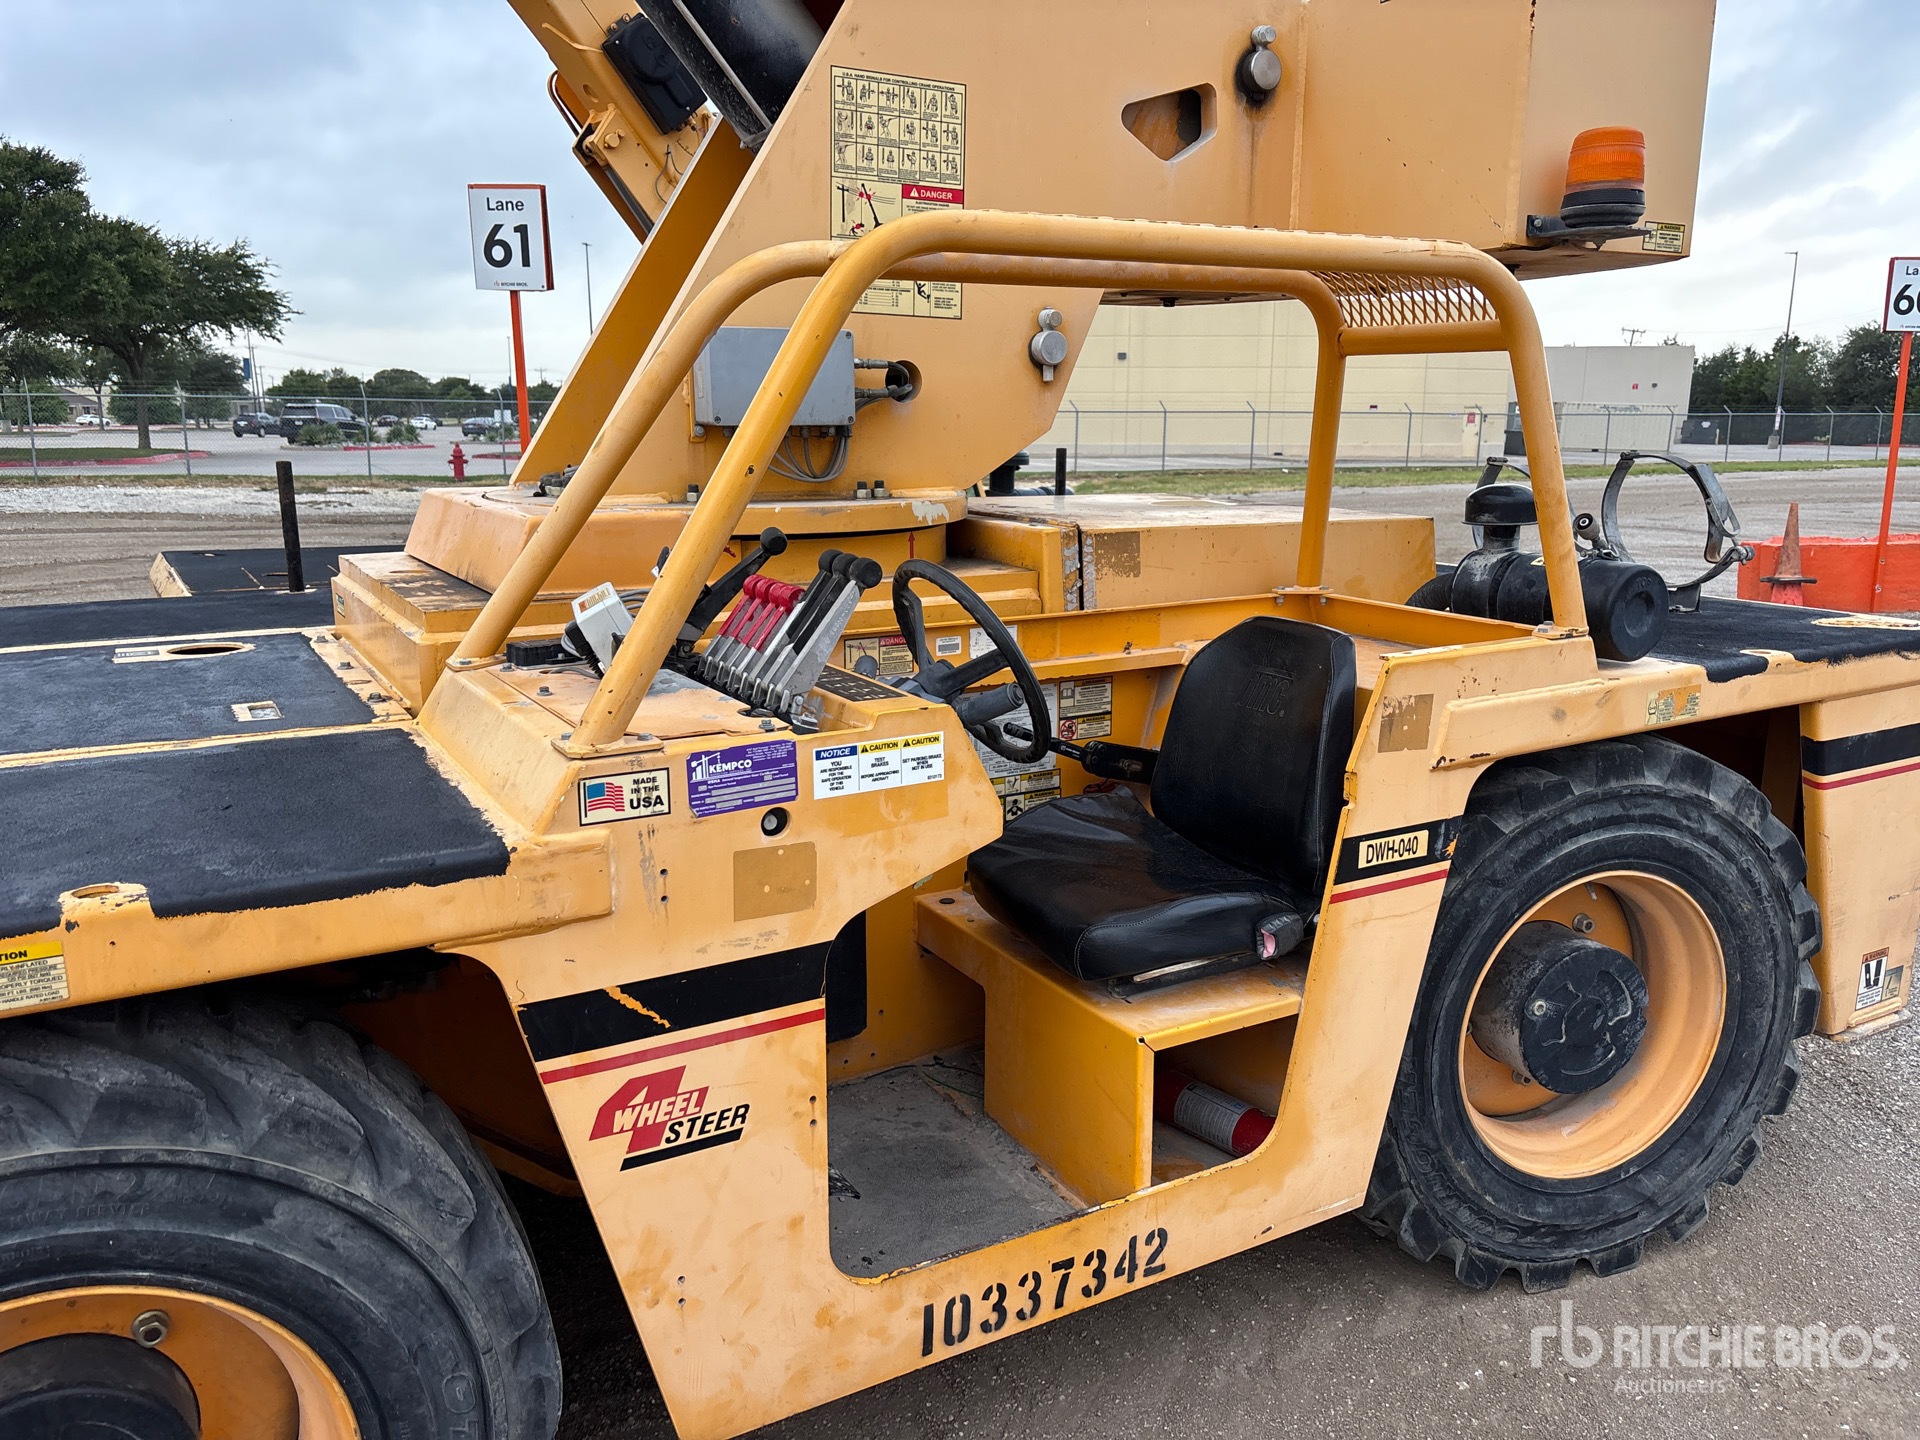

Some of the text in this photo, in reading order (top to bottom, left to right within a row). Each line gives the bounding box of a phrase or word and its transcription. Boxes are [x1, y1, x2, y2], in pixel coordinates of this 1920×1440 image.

[920, 190, 952, 200] DANGER
[486, 197, 524, 211] Lane
[484, 224, 530, 268] 61
[1905, 266, 1919, 276] La
[1893, 284, 1920, 316] 6
[911, 736, 940, 746] CAUTION
[869, 742, 899, 751] CAUTION
[821, 748, 851, 758] NOTICE
[708, 759, 752, 774] KEMPCO
[633, 776, 657, 785] MADE
[643, 785, 660, 793] THE
[629, 795, 665, 809] USA
[1366, 836, 1418, 864] DWH-040
[15, 960, 48, 970] INFLATED
[30, 975, 63, 985] TORQUED
[589, 1065, 750, 1155] 4 WHEEL STEER
[922, 1228, 1168, 1357] 10337342
